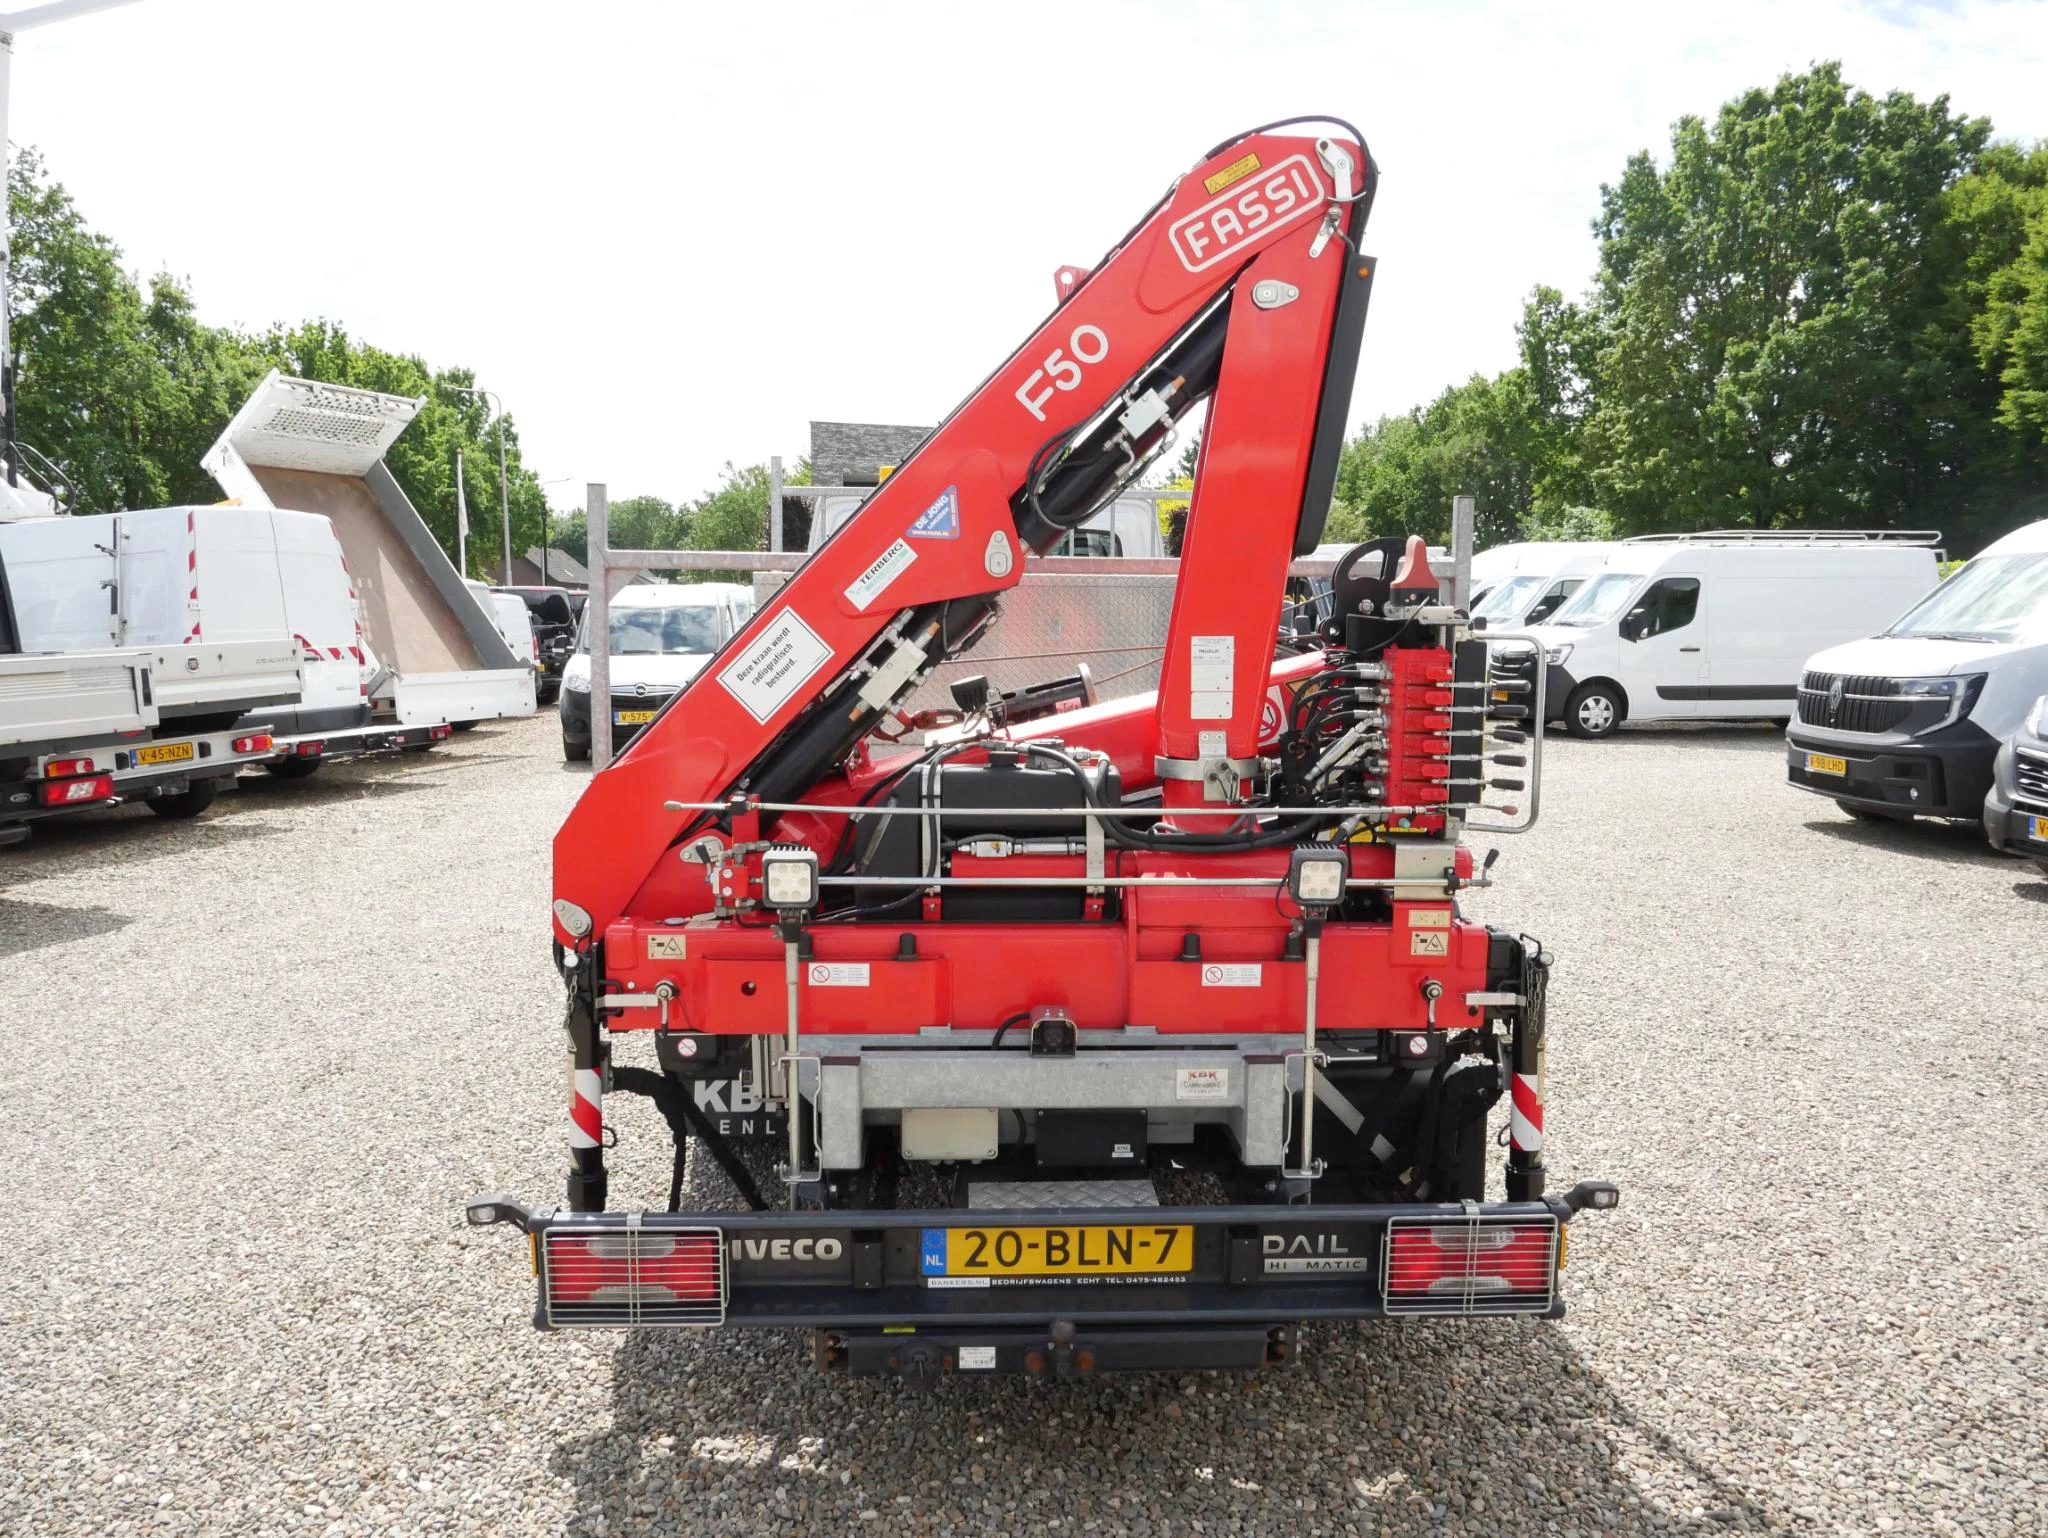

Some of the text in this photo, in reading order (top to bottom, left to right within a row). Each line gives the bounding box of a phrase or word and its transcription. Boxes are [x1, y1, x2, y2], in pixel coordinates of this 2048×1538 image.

[1184, 168, 1310, 259] FASSI
[1015, 324, 1109, 422] F50
[928, 494, 949, 519] JONG
[860, 542, 904, 585] TERBERG
[736, 627, 791, 682] Deze kraan wordt
[751, 642, 794, 686] radiografisch
[765, 657, 798, 689] bestuurd.
[139, 744, 190, 762] V-45-NZN
[693, 1079, 789, 1113] KB
[731, 1238, 842, 1261] IVECO
[925, 1254, 944, 1267] NL
[963, 1228, 1180, 1268] 20-BLN-7
[991, 1277, 1072, 1286] BEDRIJFSWAGENS
[1077, 1277, 1100, 1285] ECHT
[1306, 1261, 1361, 1269] MATIC
